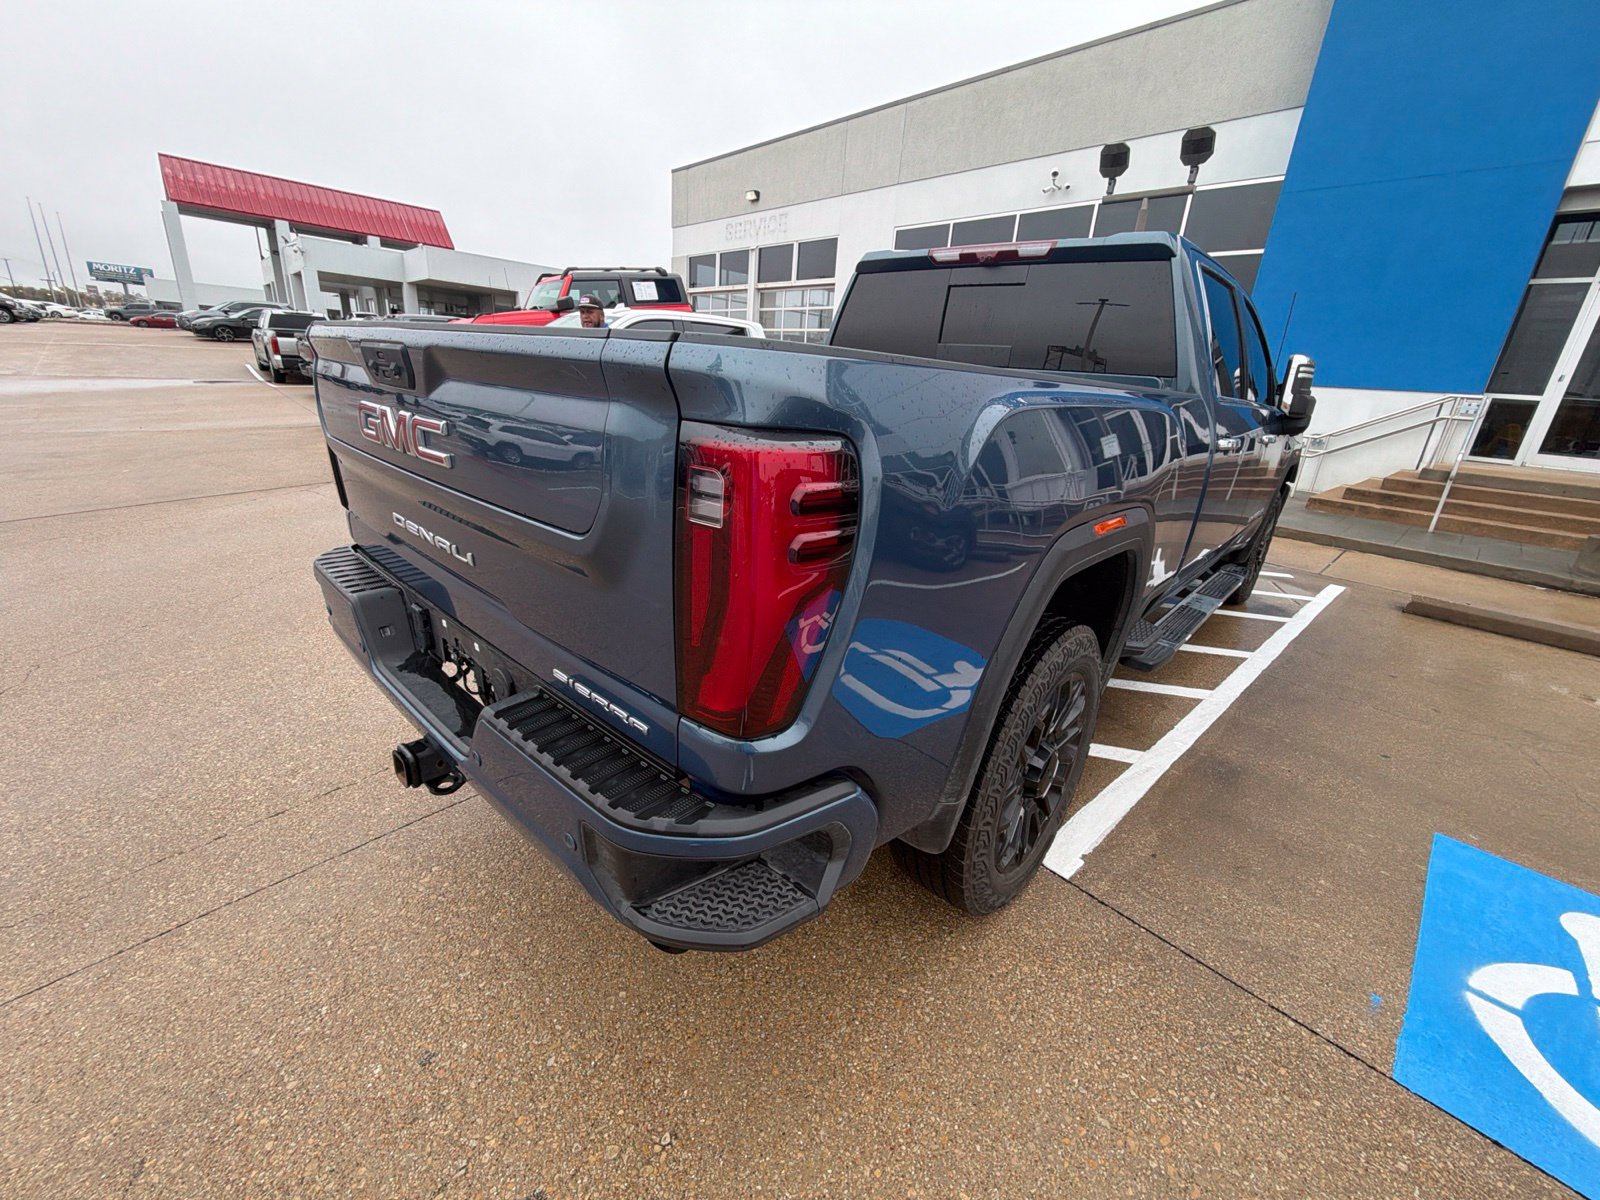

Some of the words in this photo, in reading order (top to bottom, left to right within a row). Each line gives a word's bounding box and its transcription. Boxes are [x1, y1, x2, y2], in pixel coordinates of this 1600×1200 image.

[725, 213, 788, 241] SERVICE
[92, 262, 137, 275] MORITZ
[358, 400, 455, 469] GMC
[392, 511, 476, 567] DENALI
[552, 668, 650, 736] SIERRA
